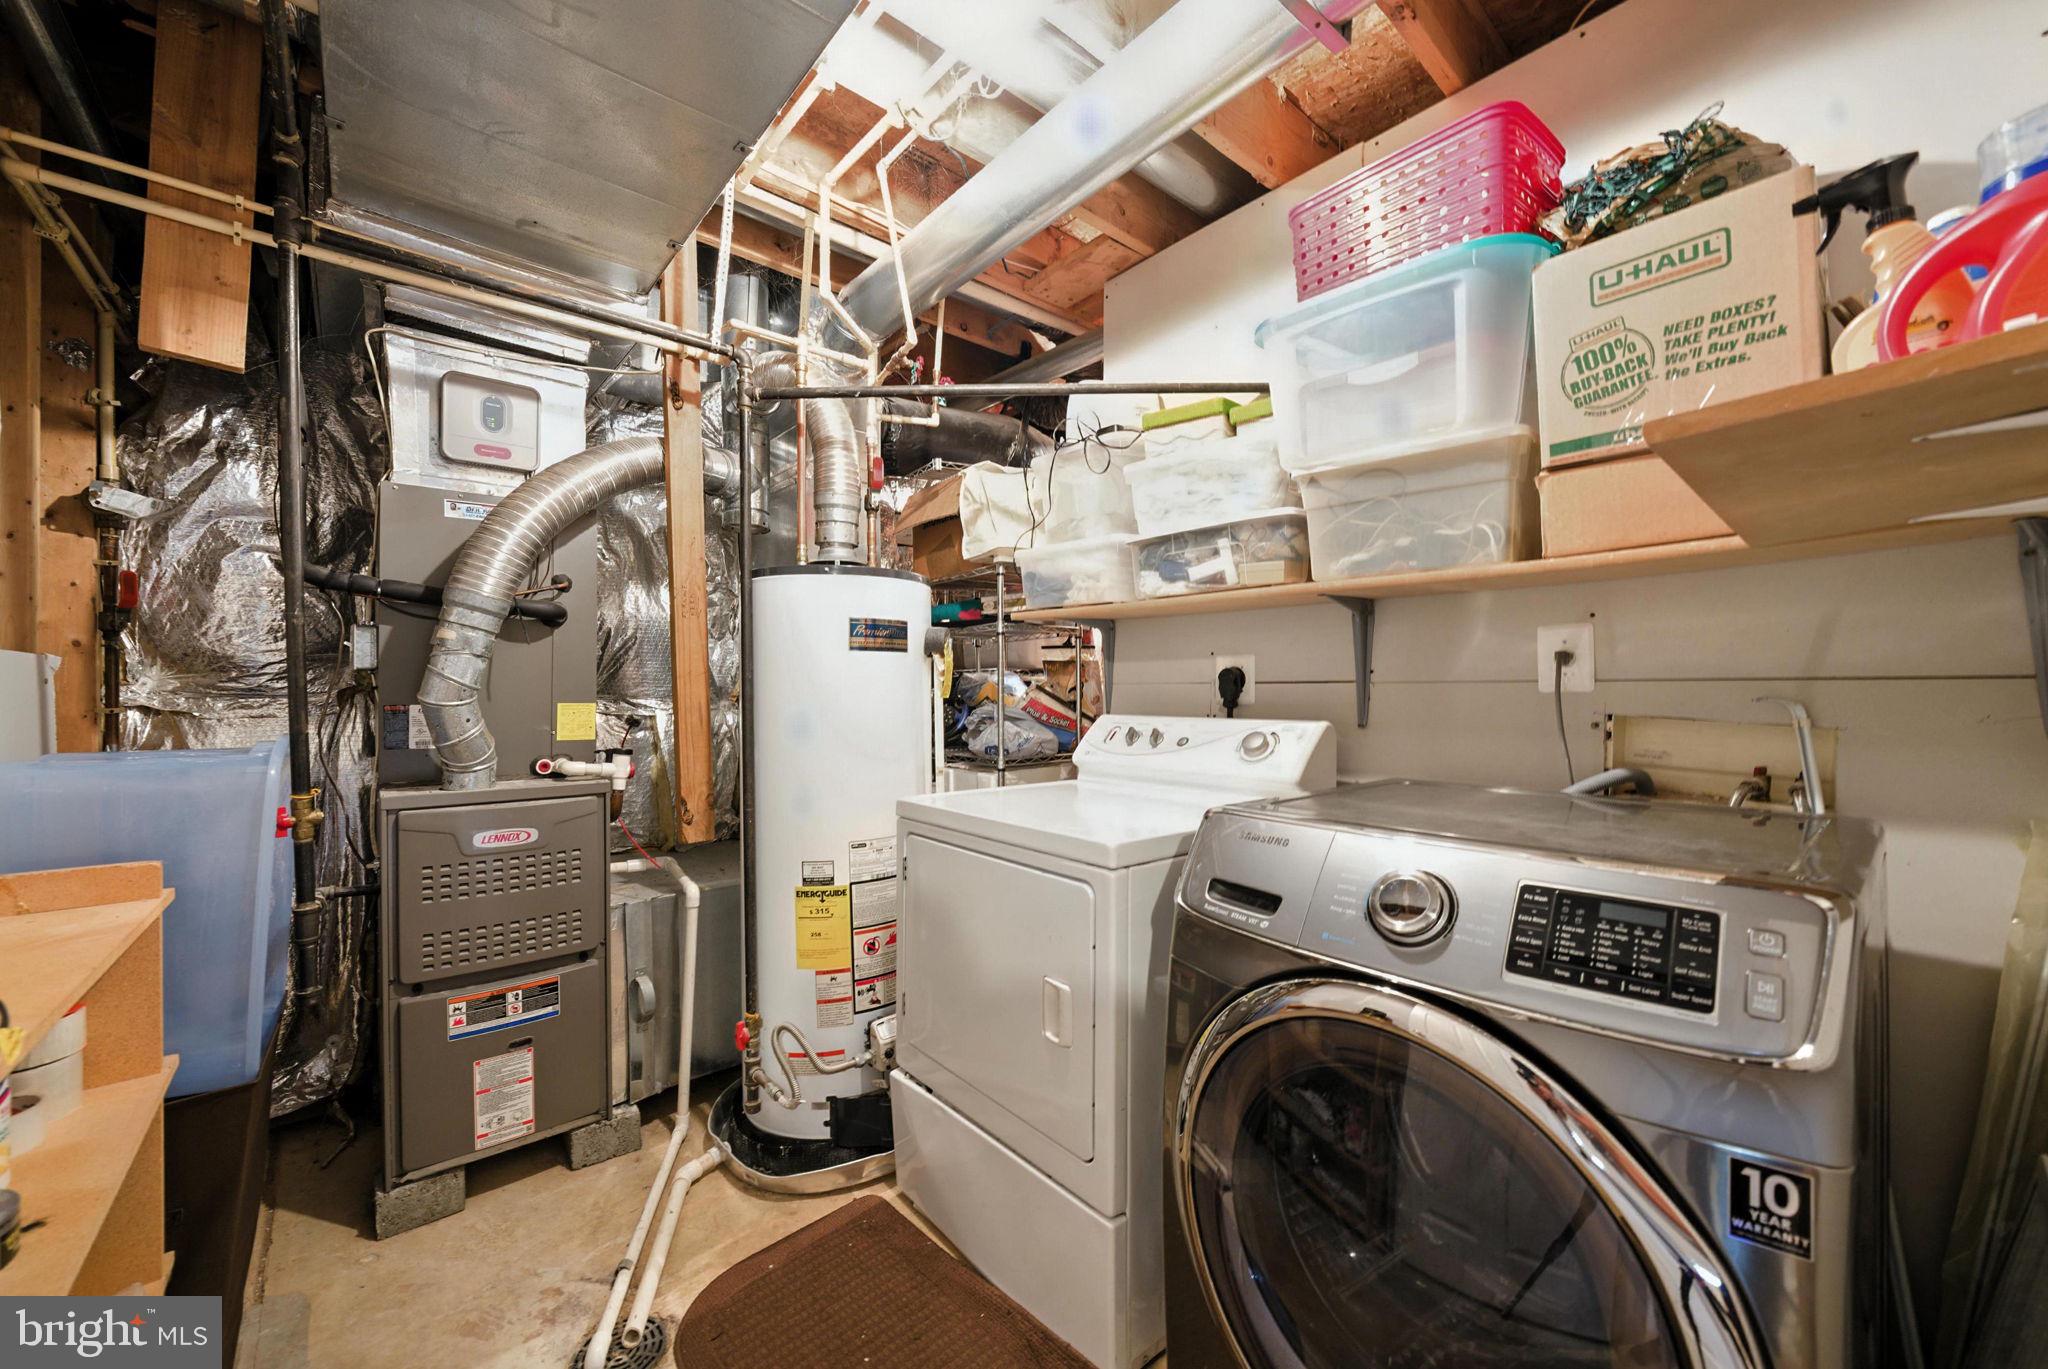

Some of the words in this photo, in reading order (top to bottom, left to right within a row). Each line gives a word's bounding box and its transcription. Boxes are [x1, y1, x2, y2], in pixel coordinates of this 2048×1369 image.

[1599, 240, 1721, 291] U-HAUL
[1663, 315, 1704, 337] NEED
[1710, 294, 1776, 323] BOXES?
[1573, 320, 1621, 346] U-HAUL
[1665, 331, 1702, 351] TAKE
[1707, 310, 1776, 339] PLENTY!
[1665, 346, 1702, 366] We'll
[1708, 339, 1739, 354] Buy
[1744, 324, 1788, 345] Back
[1571, 334, 1637, 375] 100%
[1665, 367, 1690, 381] the
[1696, 352, 1751, 373] Extras.
[1570, 353, 1648, 395] BUY-BACK
[1041, 712, 1048, 721] &
[1050, 715, 1070, 727] Socket
[481, 831, 521, 844] LENNOX
[1239, 831, 1290, 847] SAMSUNG
[796, 889, 848, 902] ENERGYGUIDE
[1518, 914, 1532, 922] Extra
[1532, 916, 1547, 924] Rinse
[1515, 935, 1530, 943] Extra
[1741, 1167, 1800, 1217] 10
[1731, 1218, 1811, 1248] WARRANTY
[1749, 1209, 1792, 1231] YEAR
